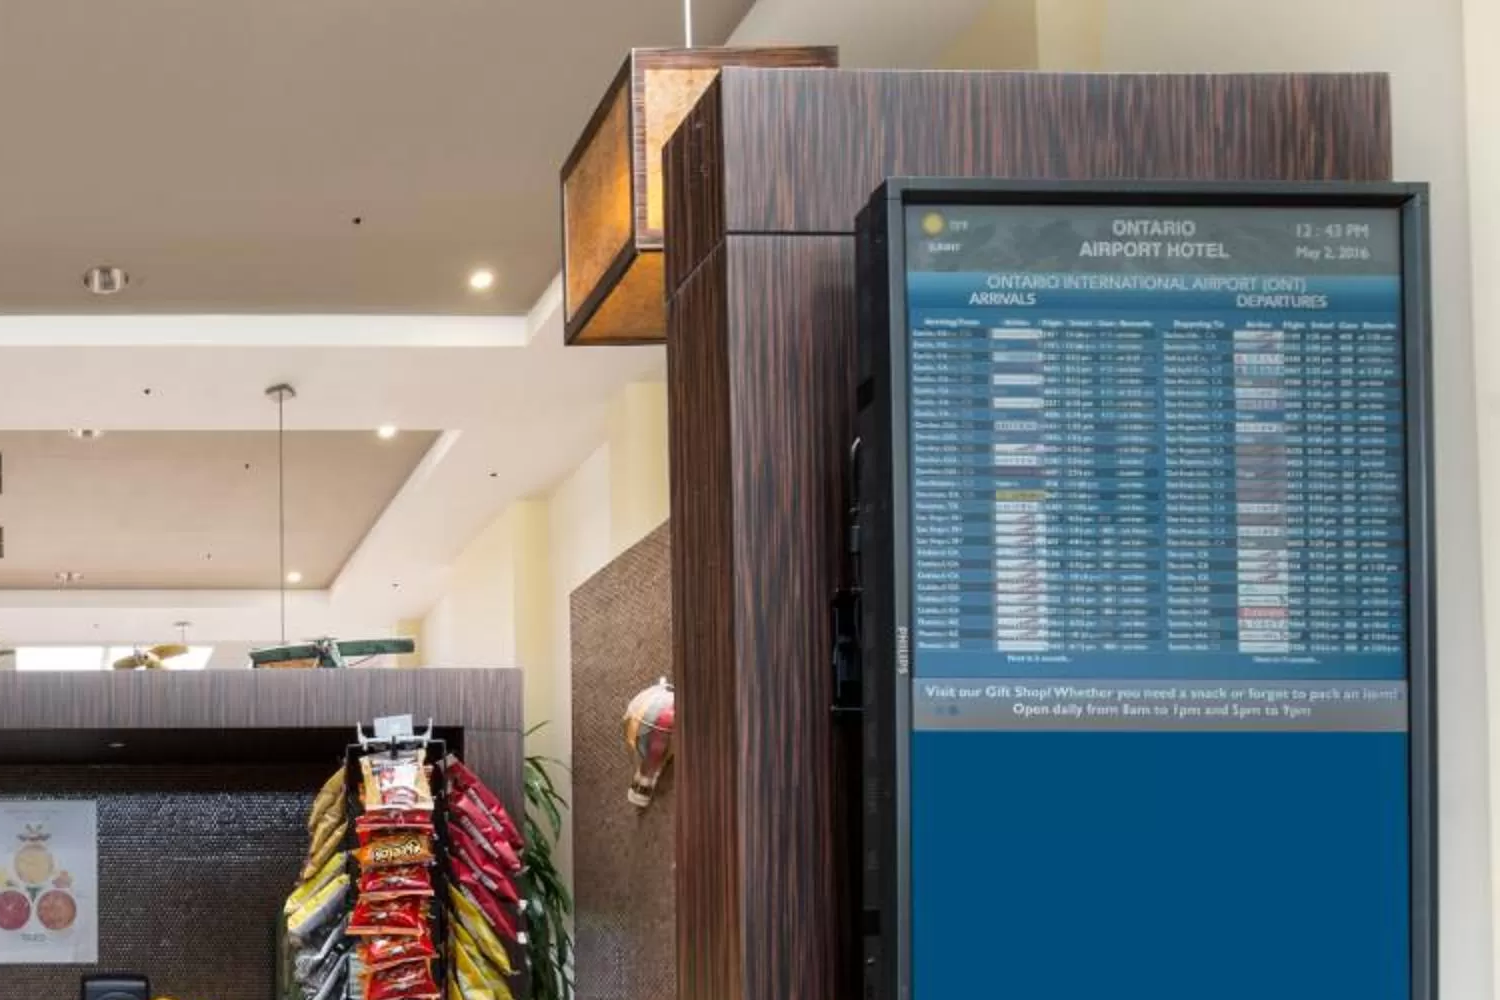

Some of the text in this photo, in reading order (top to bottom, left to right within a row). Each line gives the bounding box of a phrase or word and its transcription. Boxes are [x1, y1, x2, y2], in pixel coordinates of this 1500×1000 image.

[1112, 219, 1196, 237] ONTARIO
[1346, 223, 1370, 239] PM
[1079, 240, 1230, 259] AIRPORT HOTEL
[1295, 246, 1320, 262] May
[1339, 246, 1370, 260] 2016
[986, 273, 1059, 289] ONTARIO
[1063, 274, 1189, 291] INTERNATIONAL
[1197, 275, 1257, 291] AIRPORT
[968, 291, 1037, 306] ARRIVALS
[1236, 294, 1329, 309] DEPARTURES
[924, 685, 957, 698] Visit
[959, 688, 981, 698] our
[985, 685, 1011, 698] Gift
[1053, 686, 1112, 699] Whether
[1117, 690, 1141, 702] you
[1143, 687, 1177, 699] need
[1190, 687, 1226, 700] snack
[1230, 690, 1244, 700] or
[1291, 689, 1306, 700] to
[1309, 687, 1341, 703] pack
[1012, 703, 1050, 717] Open
[1053, 703, 1084, 718] daily
[1086, 703, 1119, 716] from
[1154, 704, 1169, 716] to
[1205, 704, 1229, 716] and
[1265, 704, 1279, 716] to
